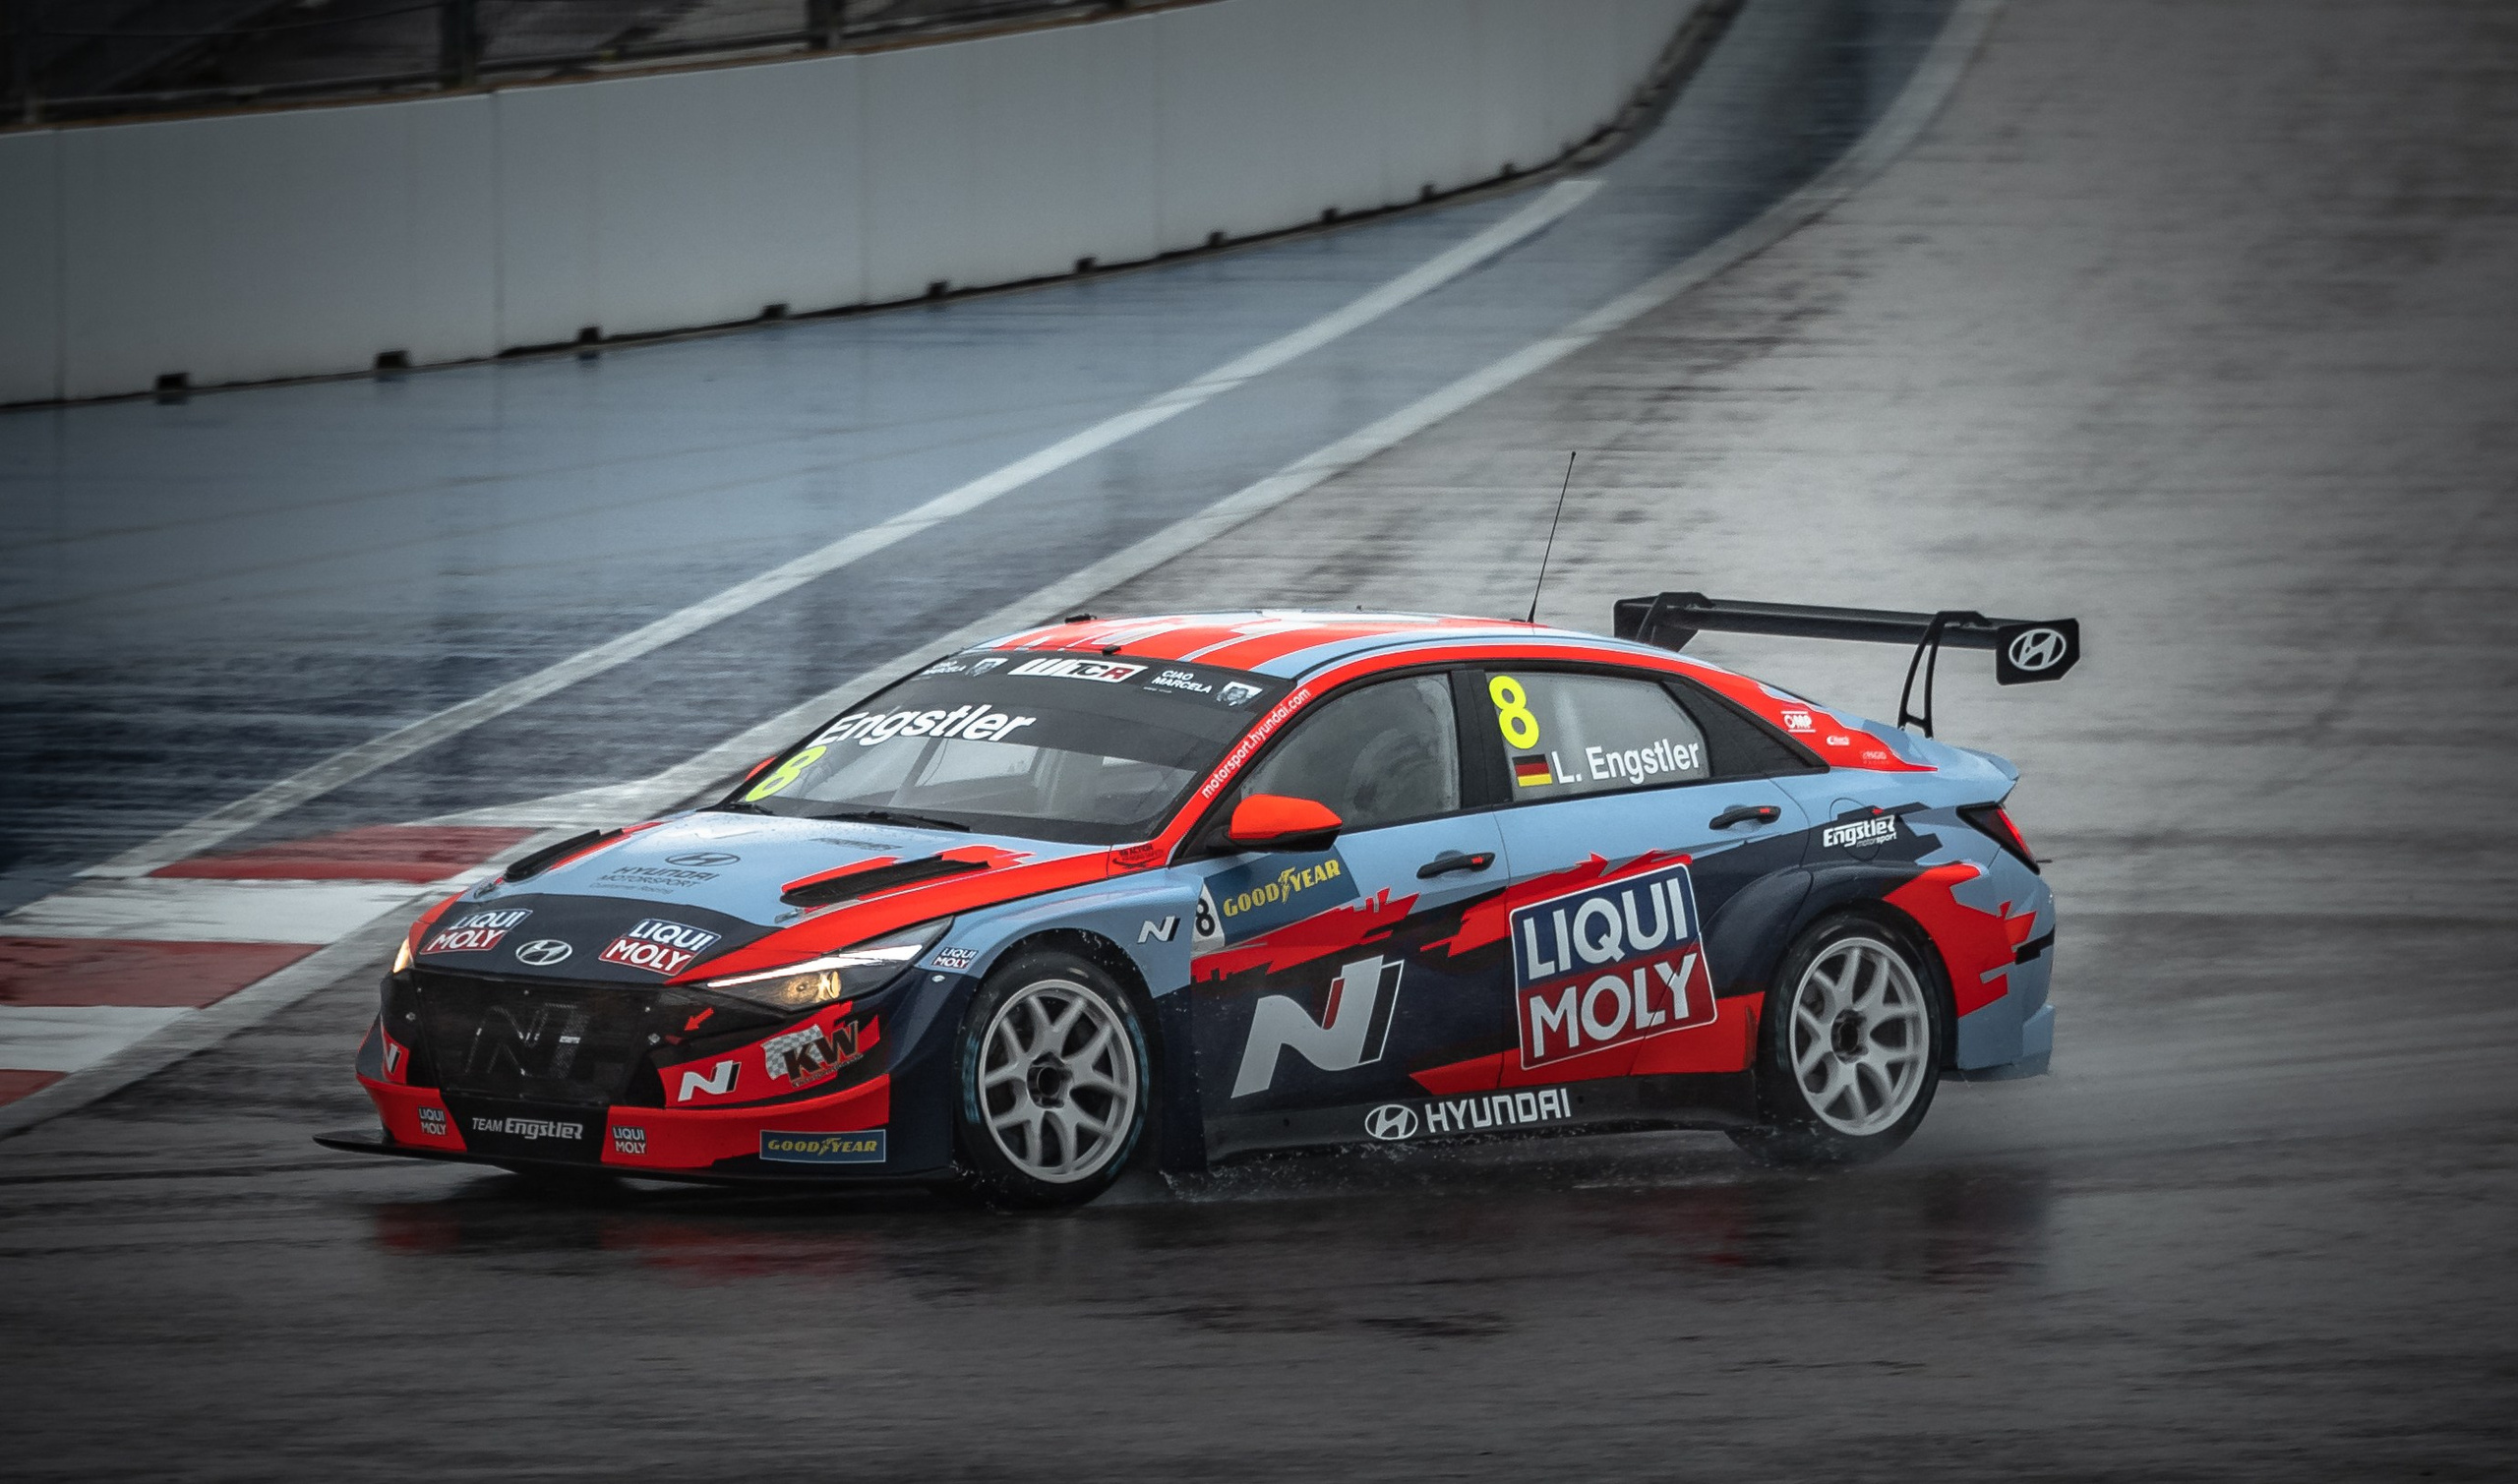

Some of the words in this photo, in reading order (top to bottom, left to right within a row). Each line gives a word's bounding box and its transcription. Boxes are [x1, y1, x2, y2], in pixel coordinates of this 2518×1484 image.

[1151, 676, 1212, 694] MARCELA
[1161, 669, 1194, 681] CIAO
[1489, 676, 1539, 749] 8
[805, 704, 1037, 746] Engstler
[1201, 688, 1311, 799] motorsport.hyundai.com
[745, 745, 826, 802] 8
[1551, 751, 1582, 785] L.
[1588, 738, 1700, 787] Engstler
[1856, 832, 1897, 847] motorsport
[613, 866, 720, 881] HYUNDAI
[1224, 859, 1341, 918] GOODYEAR
[451, 910, 526, 928] LIQUI
[1196, 898, 1216, 937] 8
[1524, 876, 1688, 980] LIQUI
[431, 928, 506, 952] MOLY
[628, 920, 715, 950] LIQUI
[605, 940, 692, 971] MOLY
[933, 957, 970, 968] MOLY
[941, 948, 977, 959] LIQUI
[1532, 954, 1699, 1057] MOLY
[783, 1021, 859, 1083] KW
[419, 1107, 445, 1120] LIQUI
[1424, 1088, 1571, 1134] HYUNDAI
[421, 1121, 447, 1135] MOLY
[472, 1117, 503, 1132] TEAM
[612, 1126, 645, 1140] LIQUI
[616, 1141, 647, 1154] MOLY
[767, 1137, 877, 1156] GOODYEAR
